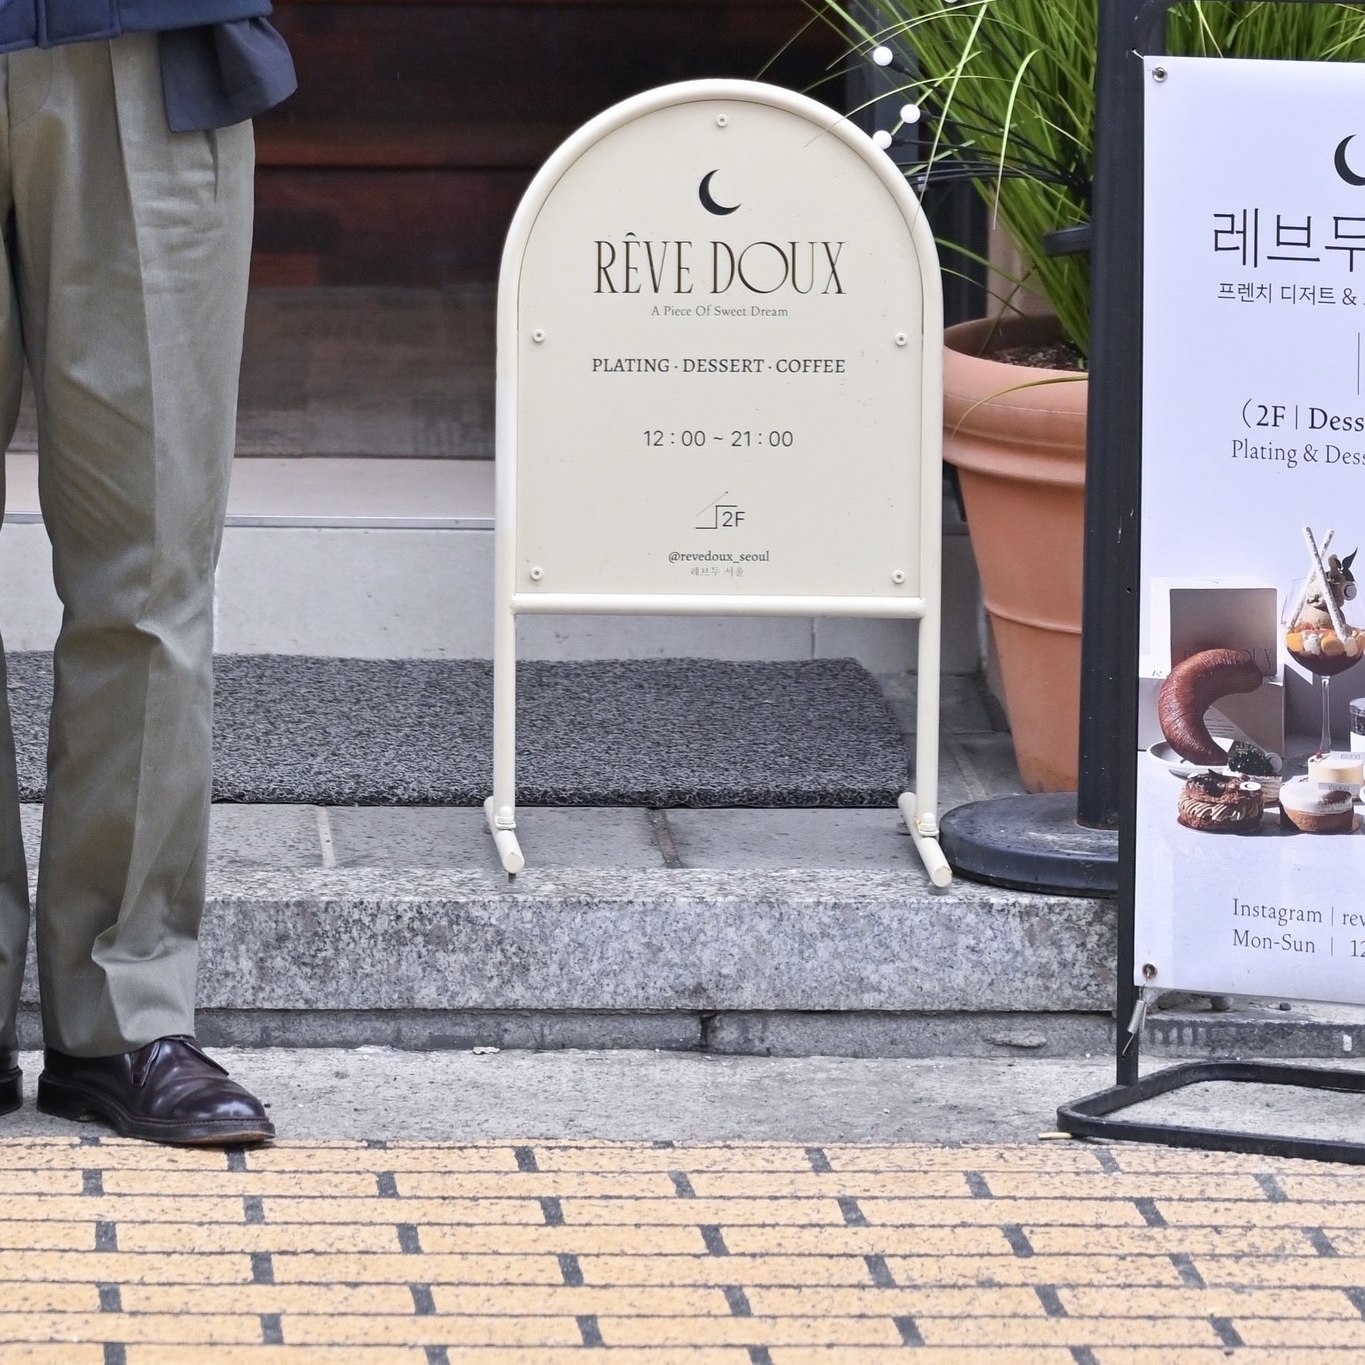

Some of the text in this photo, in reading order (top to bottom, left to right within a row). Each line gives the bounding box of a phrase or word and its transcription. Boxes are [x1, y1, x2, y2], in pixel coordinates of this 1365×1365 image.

[593, 231, 847, 295] RÊVE DOUX
[1217, 282, 1357, 306] 프렌치 디저트 &
[651, 304, 789, 316] A Piece Of Sweet Dream
[592, 358, 846, 373] PLATING DESSERT COFFEE
[1308, 407, 1365, 432] Dess
[1231, 438, 1298, 468] Plating
[1303, 443, 1319, 463] &
[722, 511, 746, 528] 2F
[668, 550, 770, 564] @revedoux_seoul
[1233, 898, 1322, 927] Instagram
[1233, 929, 1315, 954] Mon-Sun
